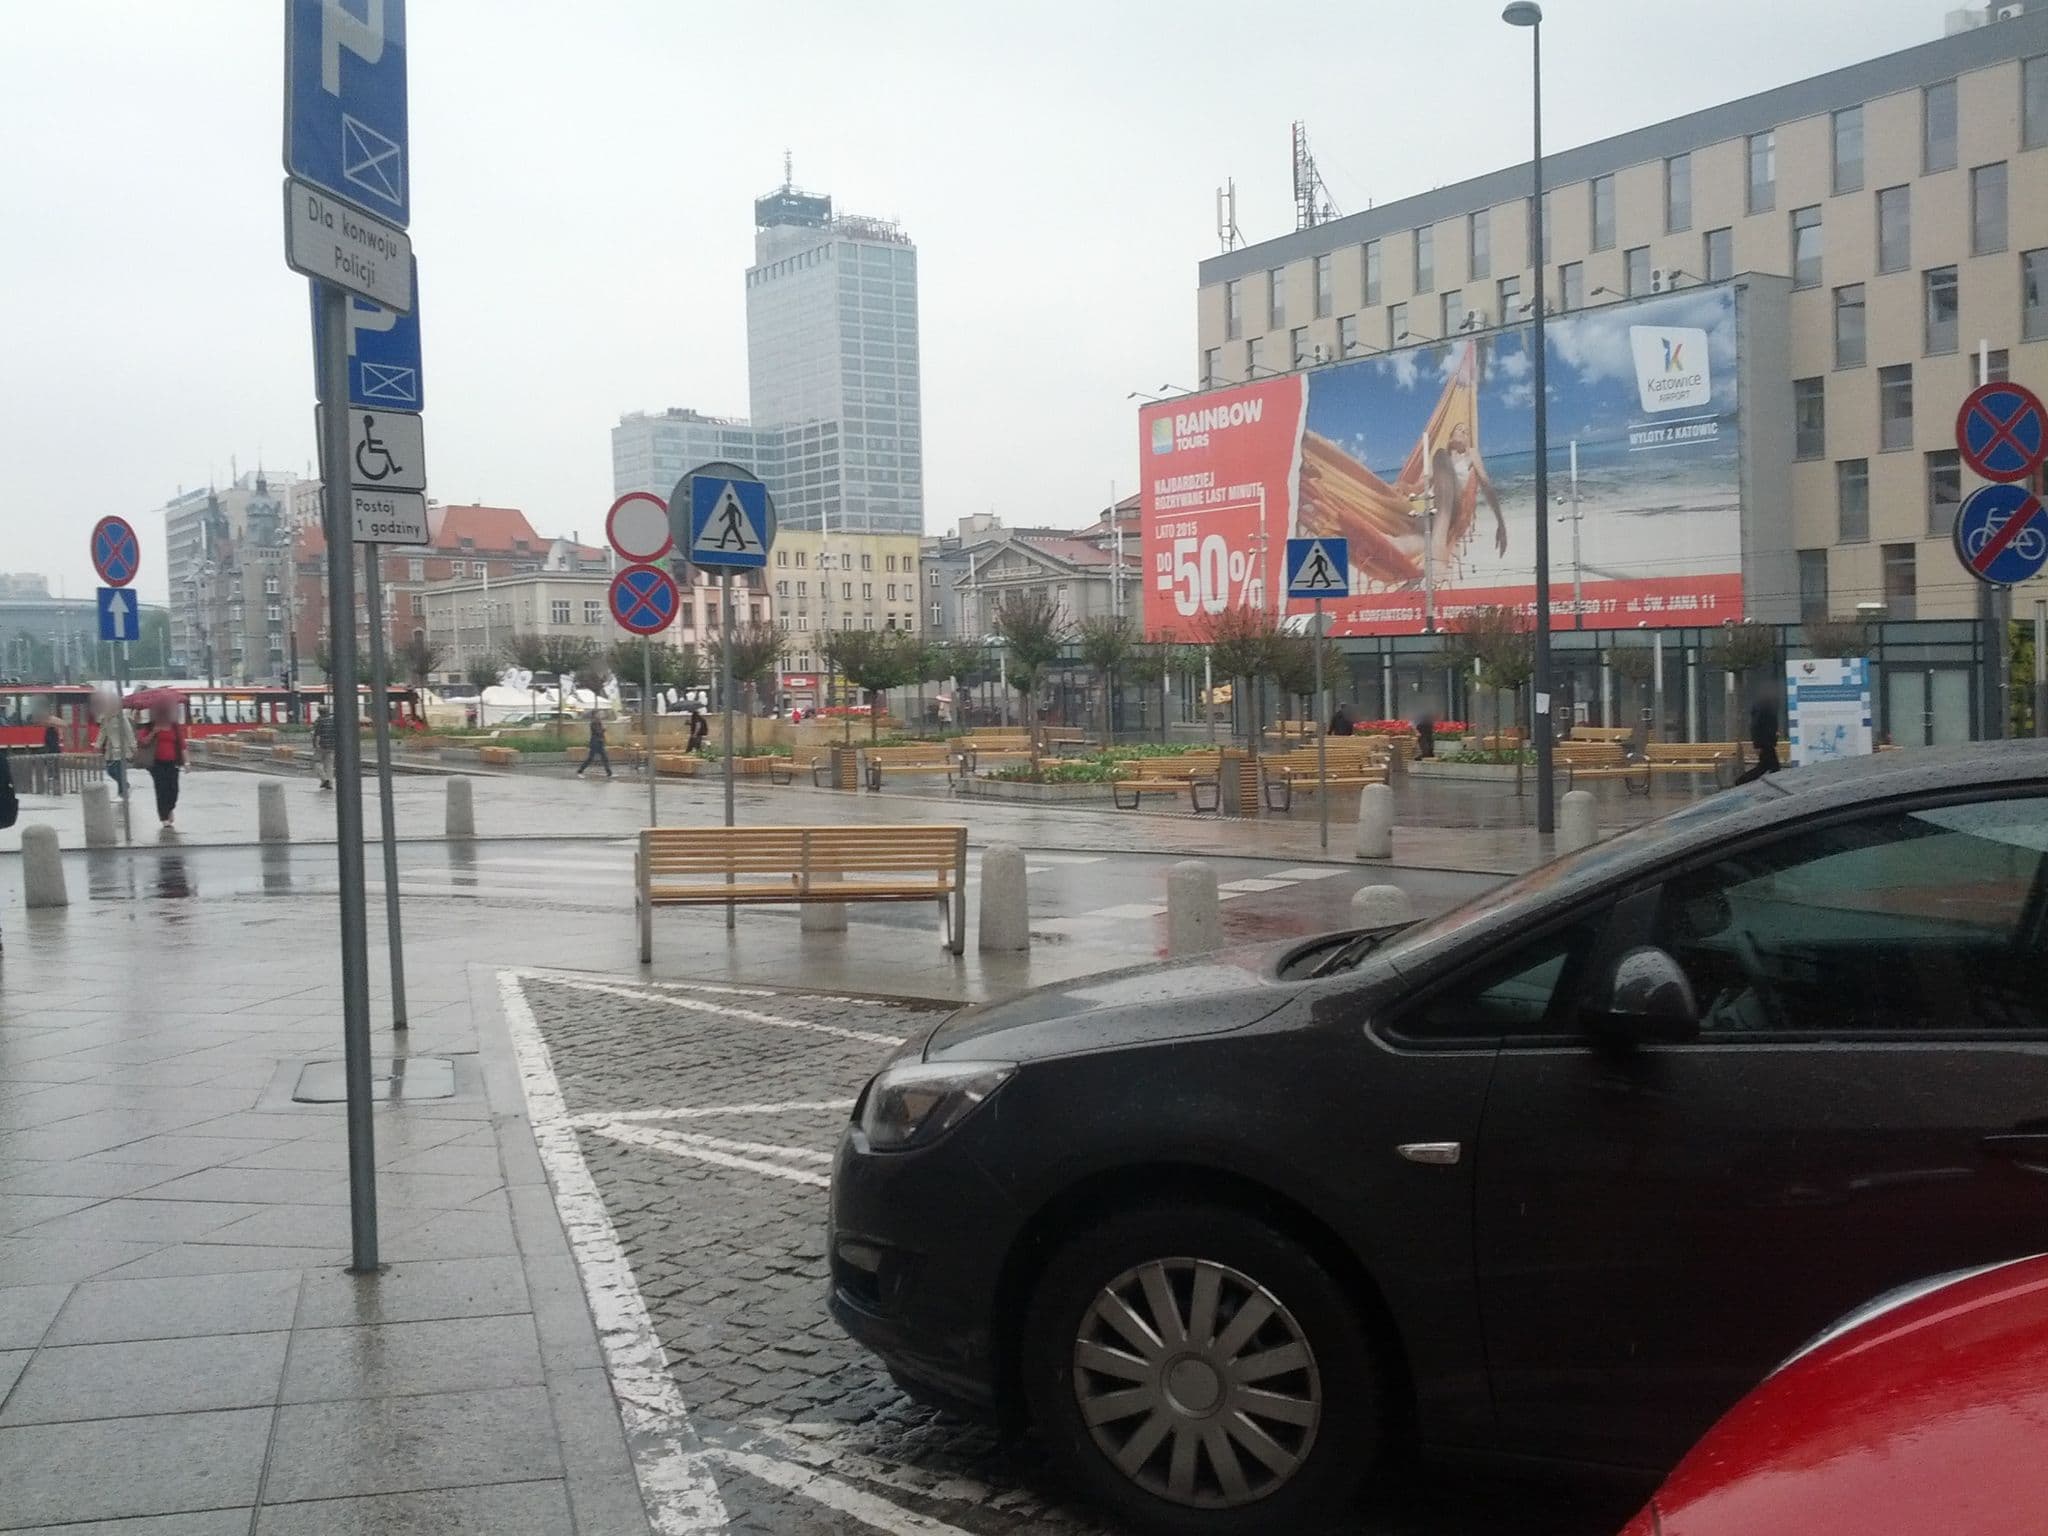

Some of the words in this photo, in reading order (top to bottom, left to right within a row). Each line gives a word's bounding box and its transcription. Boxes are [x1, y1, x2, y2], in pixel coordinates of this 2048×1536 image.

[308, 197, 333, 229] Dla
[342, 213, 397, 261] konwoju
[335, 245, 375, 288] Policji
[1648, 374, 1702, 393] Katowice
[1659, 390, 1691, 403] AIRPORT
[1176, 398, 1263, 437] RAINBOW
[1666, 428, 1674, 441] Z
[1675, 422, 1719, 439] KATOWIC
[1176, 433, 1210, 451] TOURS
[1205, 487, 1227, 504] LAST
[1228, 482, 1264, 501] MINUTE
[358, 520, 364, 532] 1
[372, 520, 421, 537] godziny
[1155, 524, 1175, 540] LATO
[1175, 521, 1198, 537] 2015
[1156, 552, 1172, 572] DO
[1603, 598, 1617, 613] 17
[1667, 595, 1698, 611] JANA
[1701, 594, 1716, 609] 11
